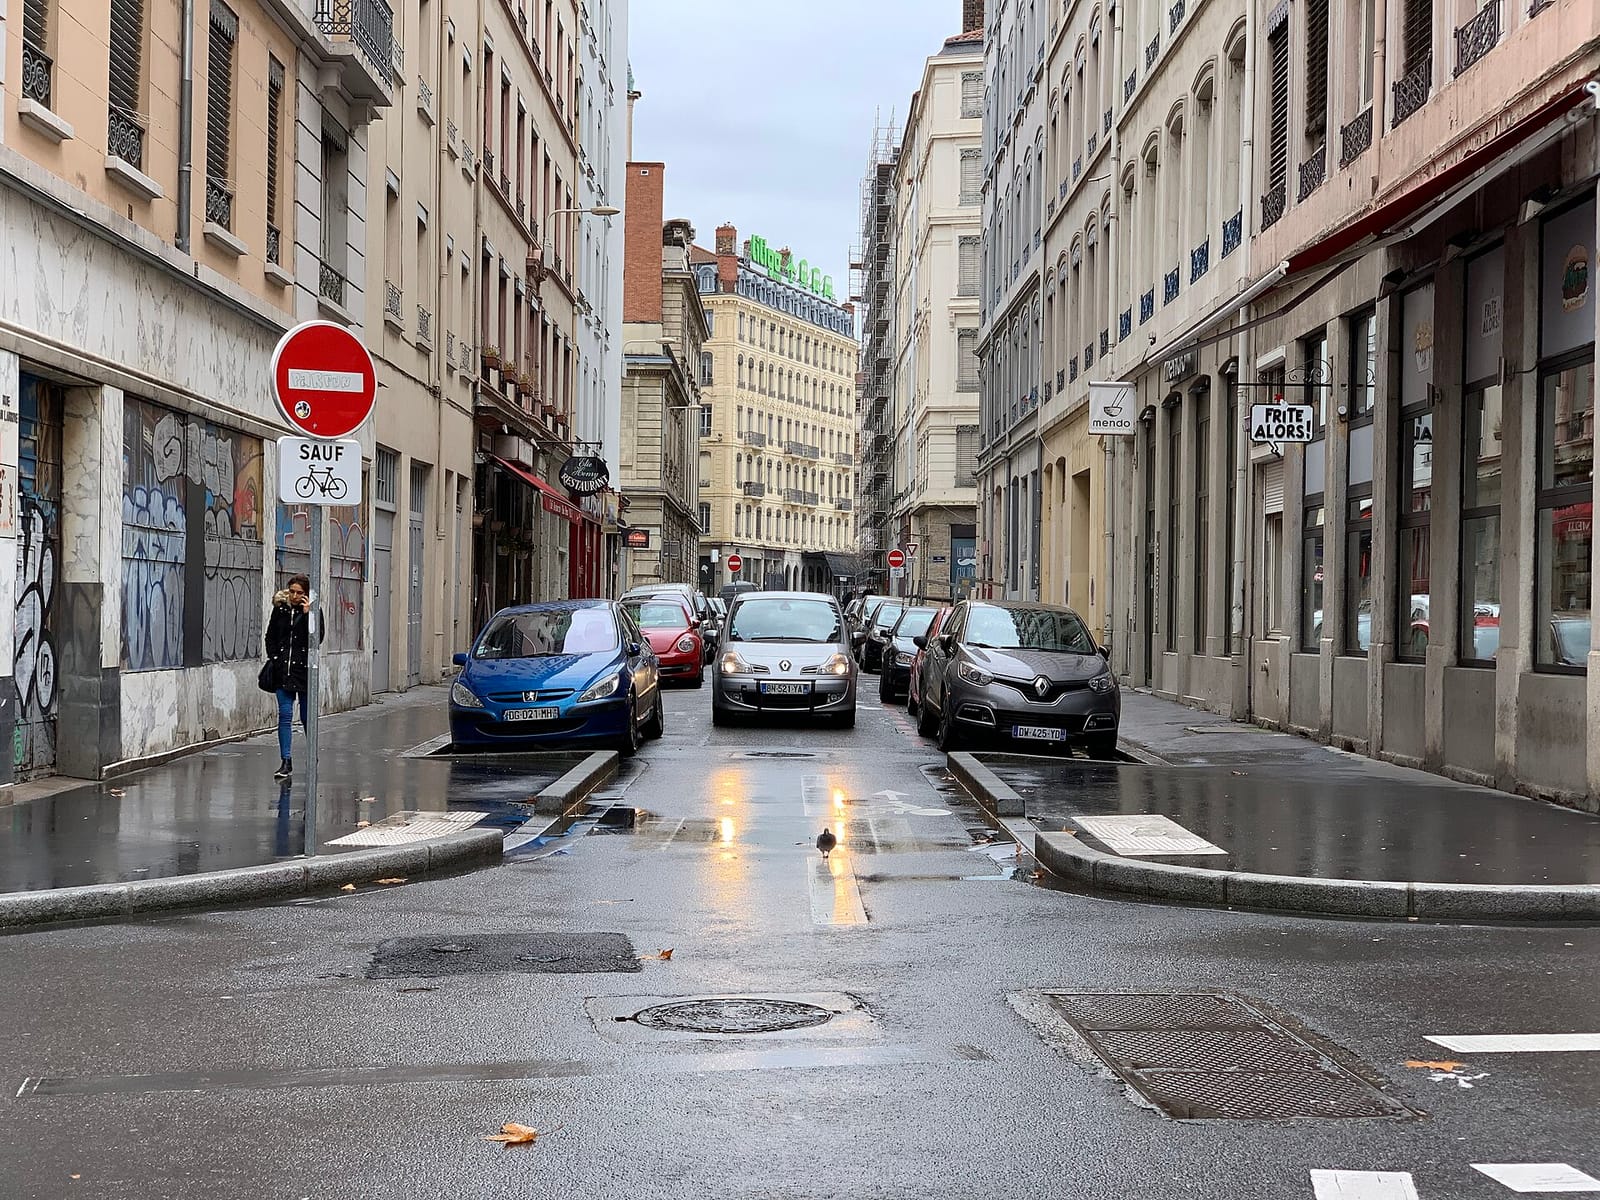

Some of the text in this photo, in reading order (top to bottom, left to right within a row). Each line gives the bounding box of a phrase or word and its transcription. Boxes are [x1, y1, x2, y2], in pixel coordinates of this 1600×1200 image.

[1092, 419, 1131, 428] mendo
[1265, 408, 1304, 423] FRITE
[1254, 420, 1311, 440] ALORS!
[299, 444, 344, 461] SAUF
[561, 472, 609, 492] RESTAURANT
[1019, 727, 1060, 739] DW-425-YD
